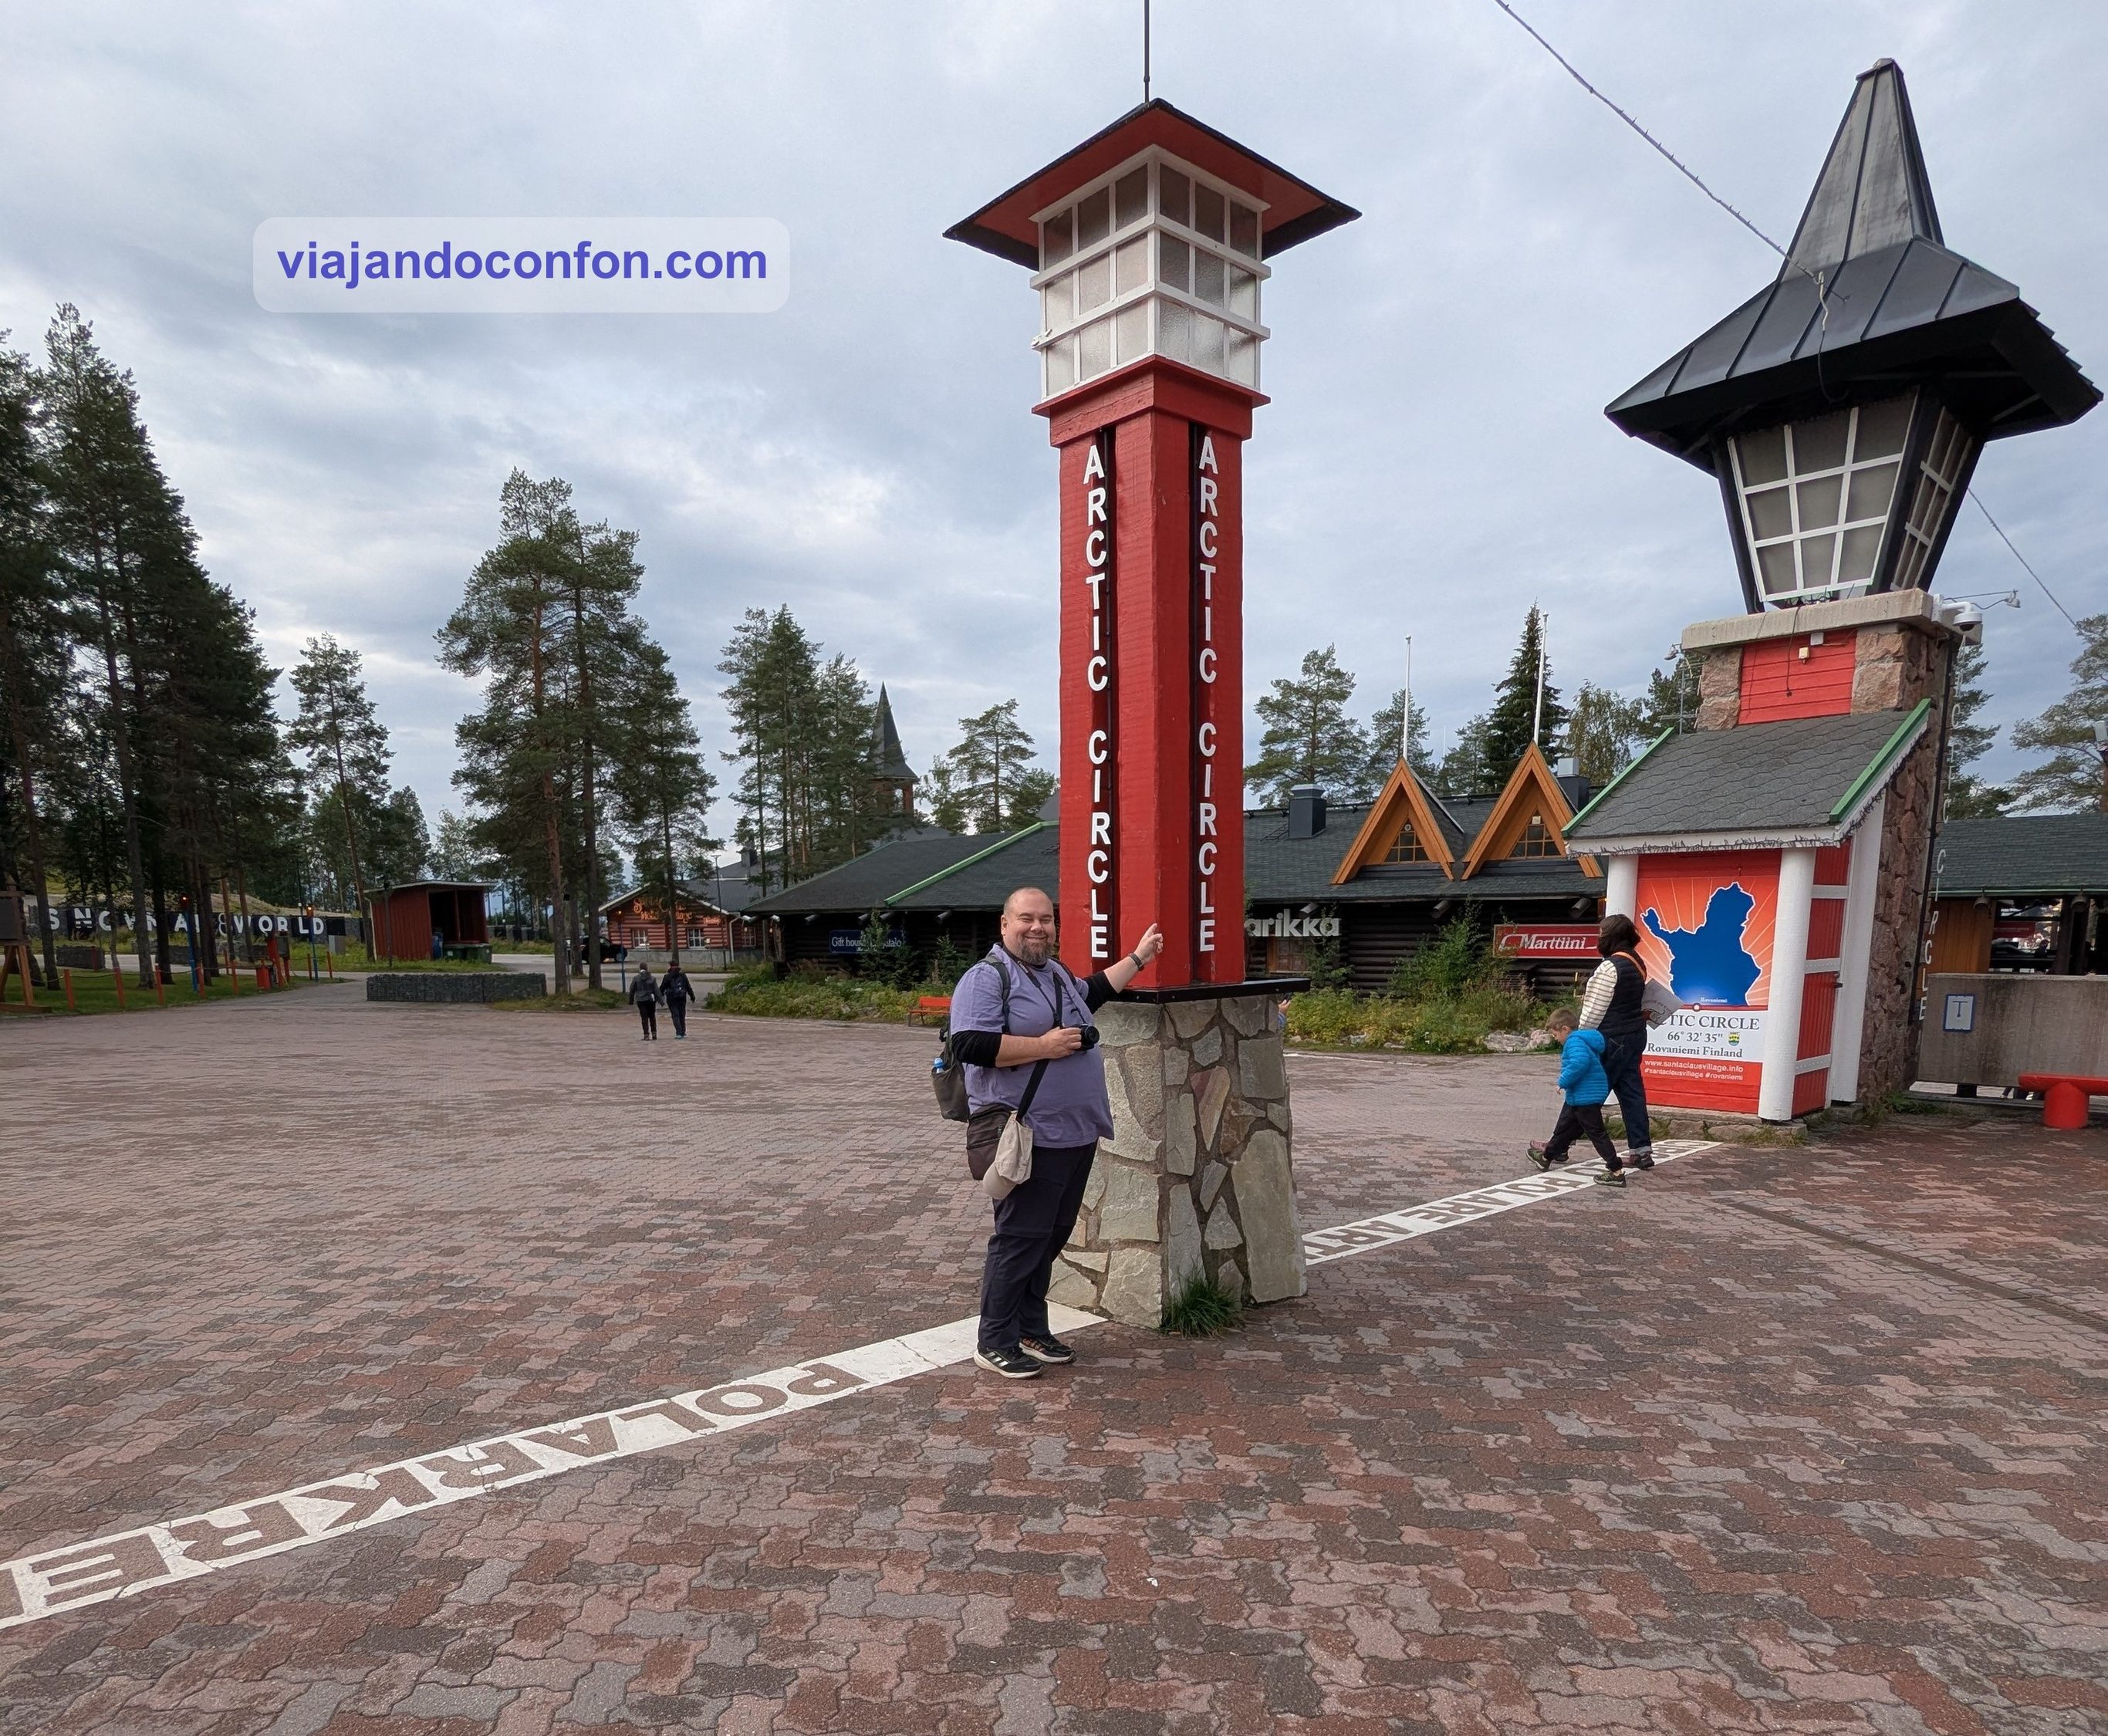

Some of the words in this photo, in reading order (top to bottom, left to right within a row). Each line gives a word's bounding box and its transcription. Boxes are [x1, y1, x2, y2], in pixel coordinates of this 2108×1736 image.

[1083, 444, 1108, 691] ARCTIC
[1198, 436, 1218, 684] ARCTIC
[1087, 730, 1111, 958] CIRCLE
[1198, 722, 1218, 952] CIRCLE
[234, 915, 324, 935] WORLD
[1919, 849, 1946, 1021] CIRCLE
[832, 937, 844, 947] Gift
[1667, 1031, 1684, 1041] 66°
[1699, 1016, 1759, 1030] CIRCLE
[1644, 1060, 1744, 1072] www.santaclausvillage.info
[1647, 1043, 1700, 1055] Rovaniemi
[1703, 1047, 1742, 1058] Finland
[1397, 1177, 1588, 1224] POLARE
